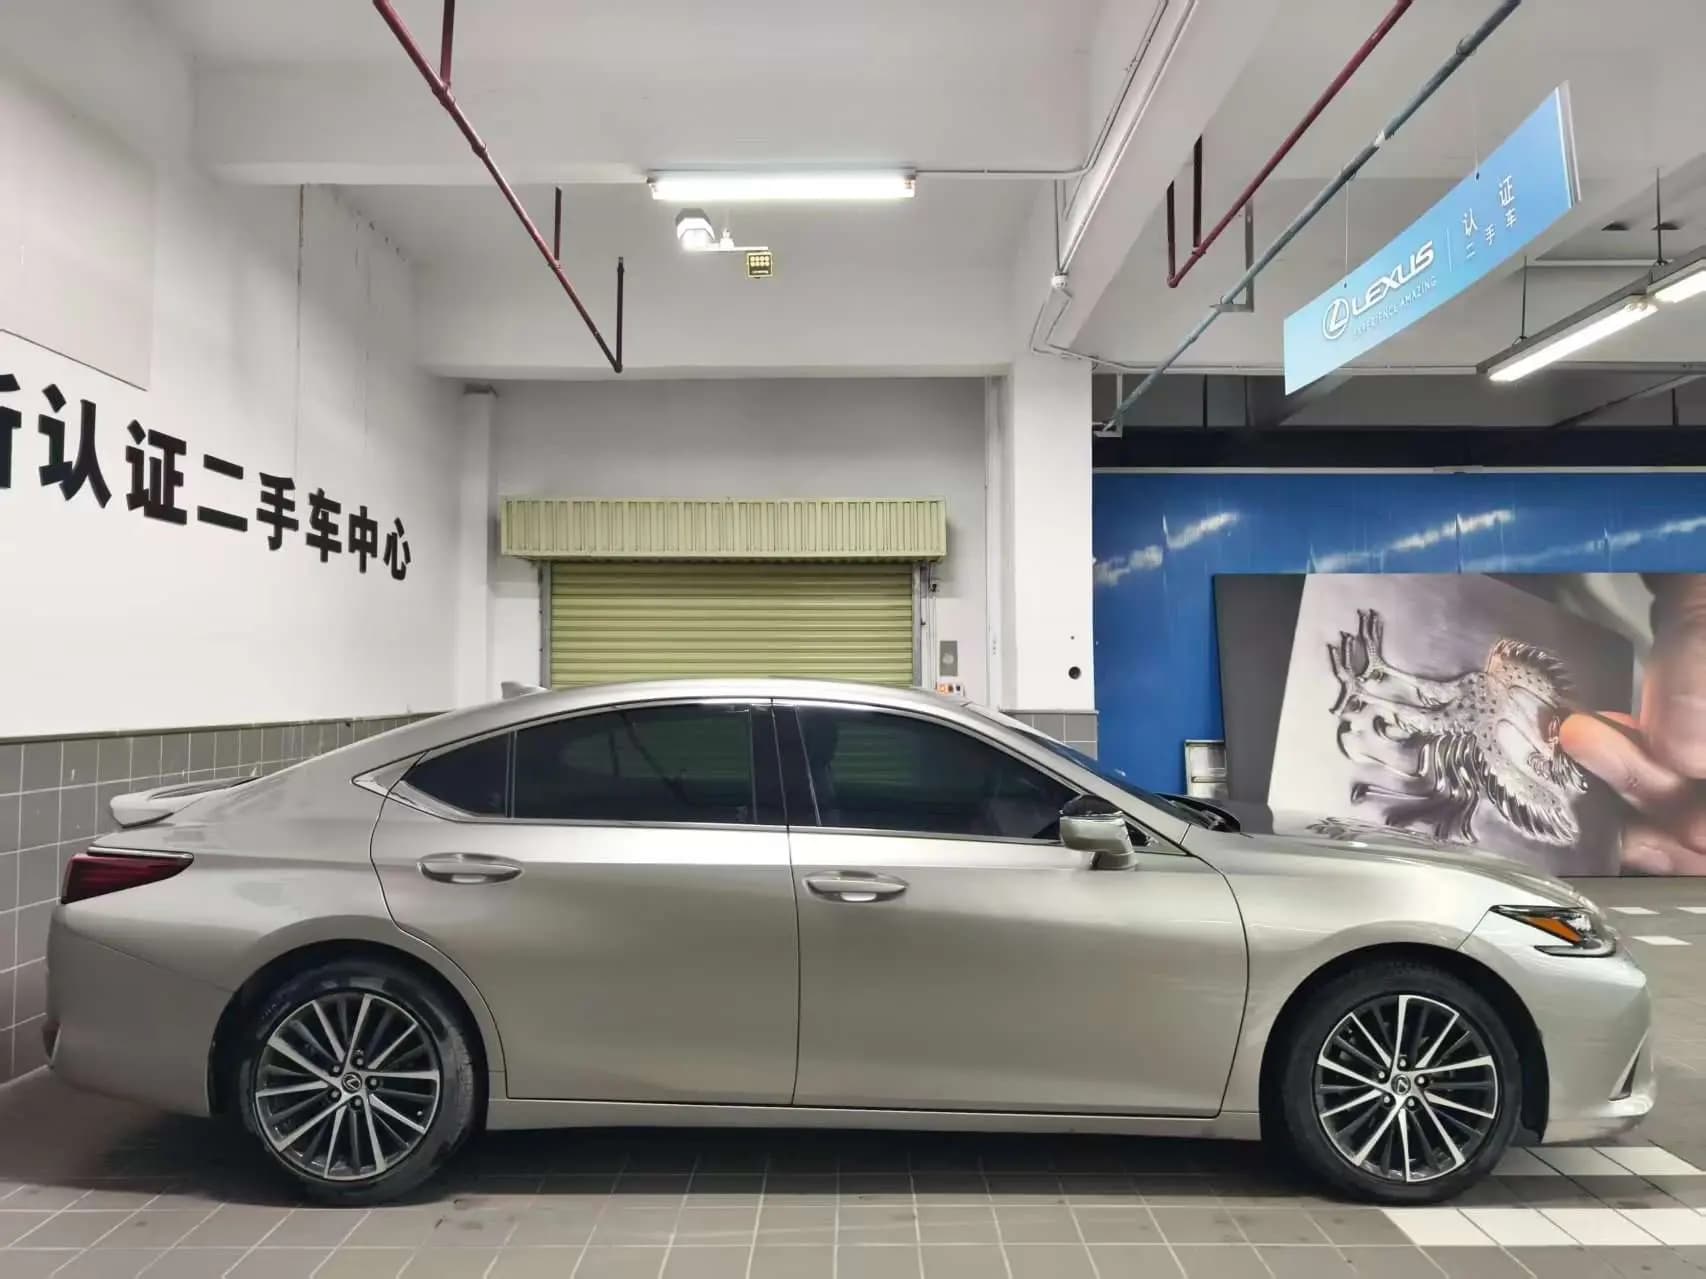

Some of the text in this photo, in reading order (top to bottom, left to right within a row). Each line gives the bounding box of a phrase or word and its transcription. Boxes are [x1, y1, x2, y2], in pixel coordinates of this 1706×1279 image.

[1462, 175, 1515, 236] 认证
[1465, 207, 1517, 258] 二手车
[1352, 240, 1434, 315] LEXUS
[0, 373, 411, 581] 认证二手车中心
